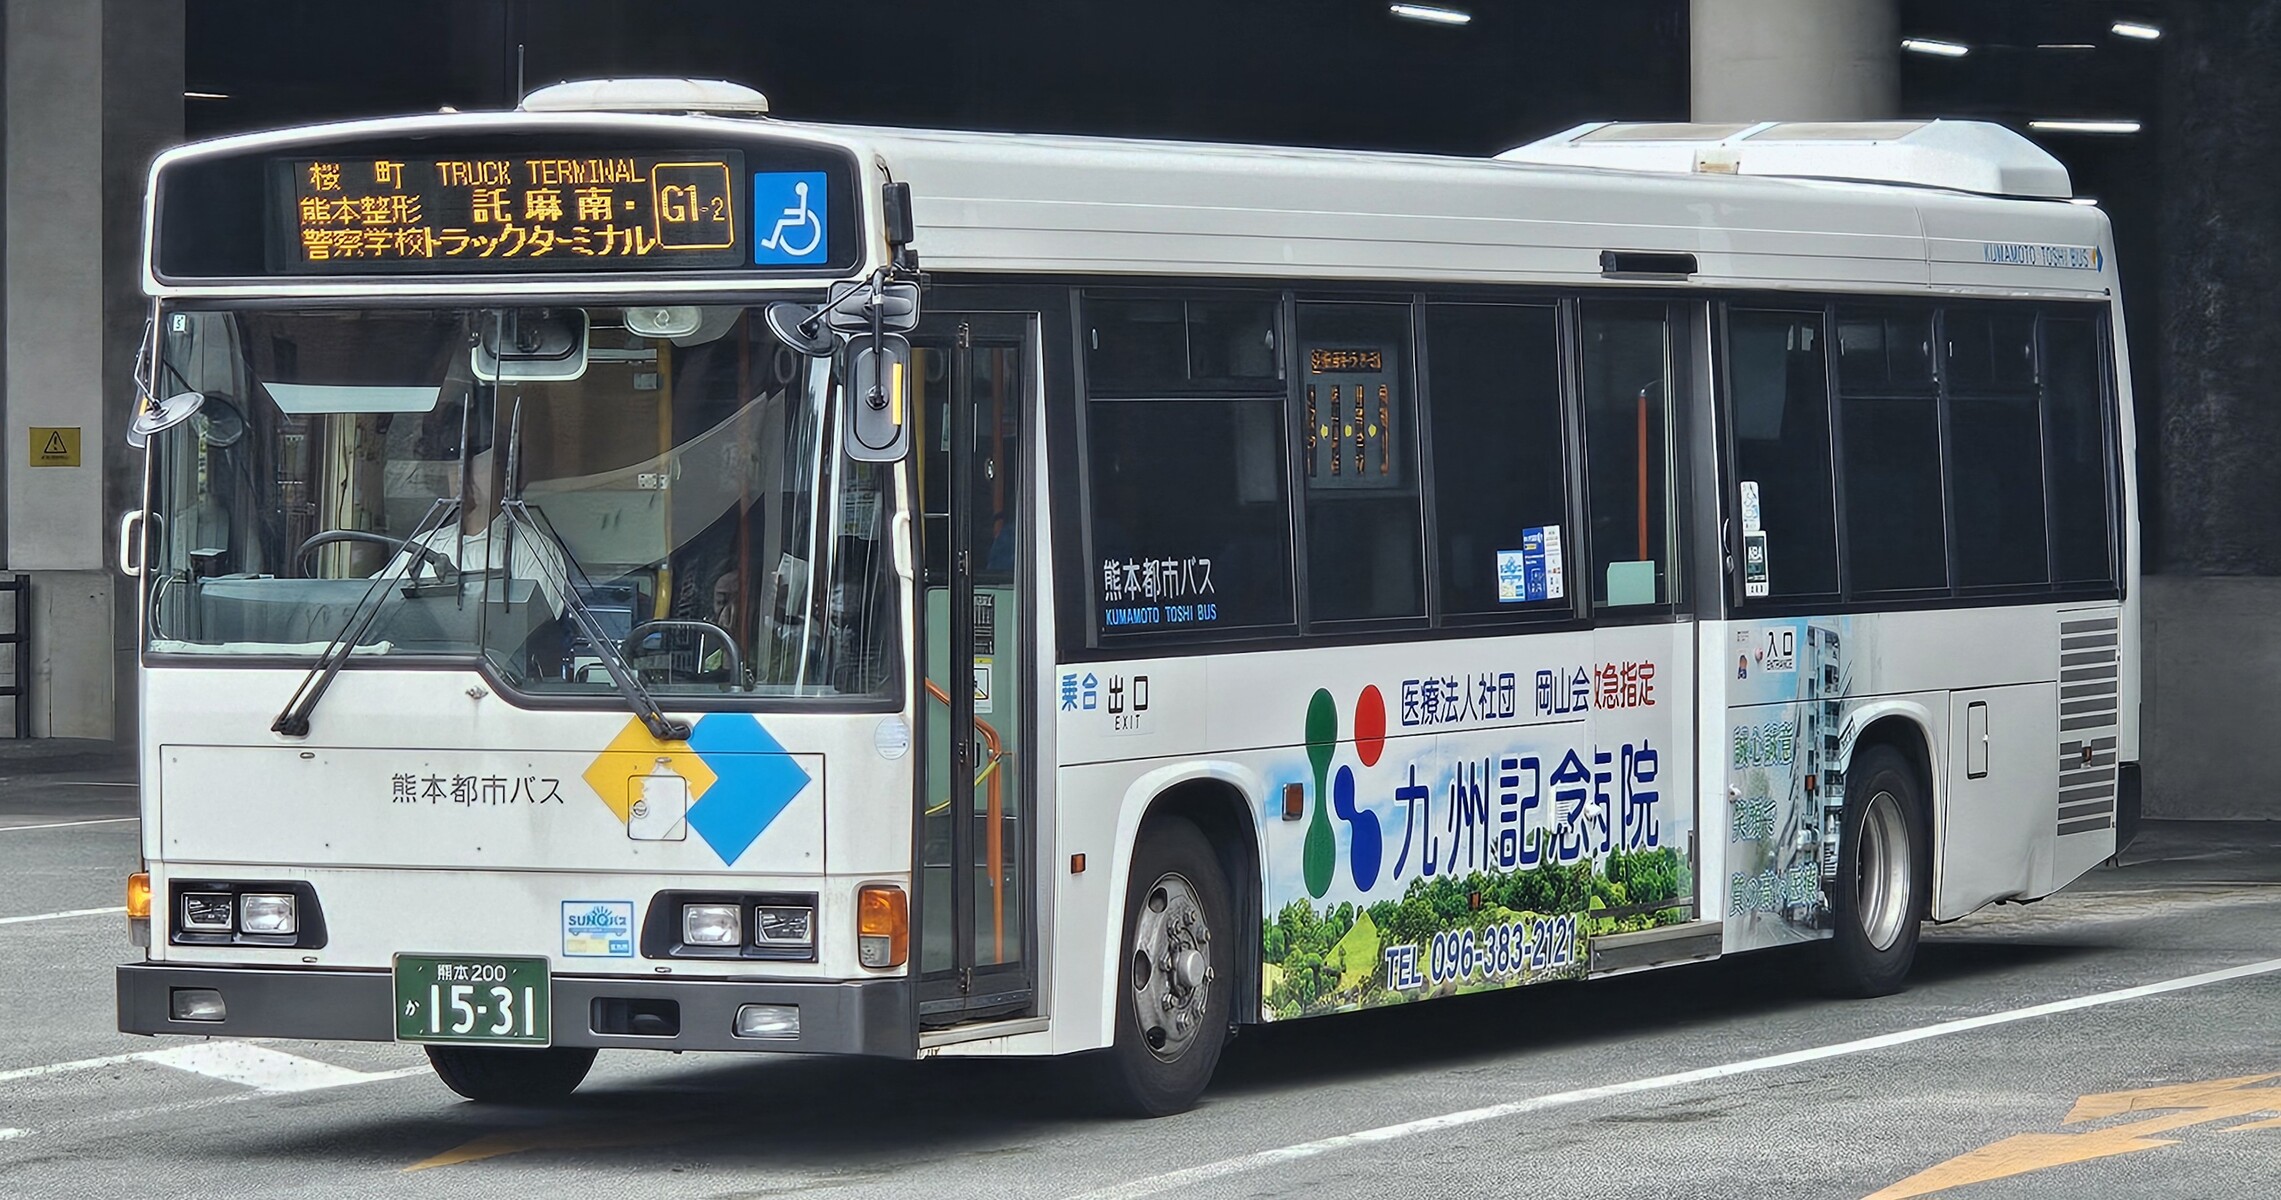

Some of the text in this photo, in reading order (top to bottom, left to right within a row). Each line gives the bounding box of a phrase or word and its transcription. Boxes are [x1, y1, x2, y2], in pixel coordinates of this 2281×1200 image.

[436, 158, 646, 186] TRUCK TERMINAL
[300, 195, 422, 225] 熊本整形
[302, 227, 424, 260] 警察学校
[425, 223, 656, 257] トラックターミナル
[1984, 243, 2088, 267] KUMAMOTO TOSHI BUS
[1104, 556, 1215, 602] 熊本都市バス
[1106, 603, 1217, 626] KUMAMOTO TOSHI BUS
[1767, 631, 1793, 657] 入口
[1062, 672, 1149, 714] 乗合 出口
[1401, 672, 1515, 726] 医療法人社団
[1535, 666, 1590, 716] 岡山会
[1115, 714, 1141, 730] EXIT
[392, 773, 563, 807] 熊本都市バス
[1386, 915, 1576, 988] TEL 096-383-2121
[404, 984, 534, 1035] か 15-31
